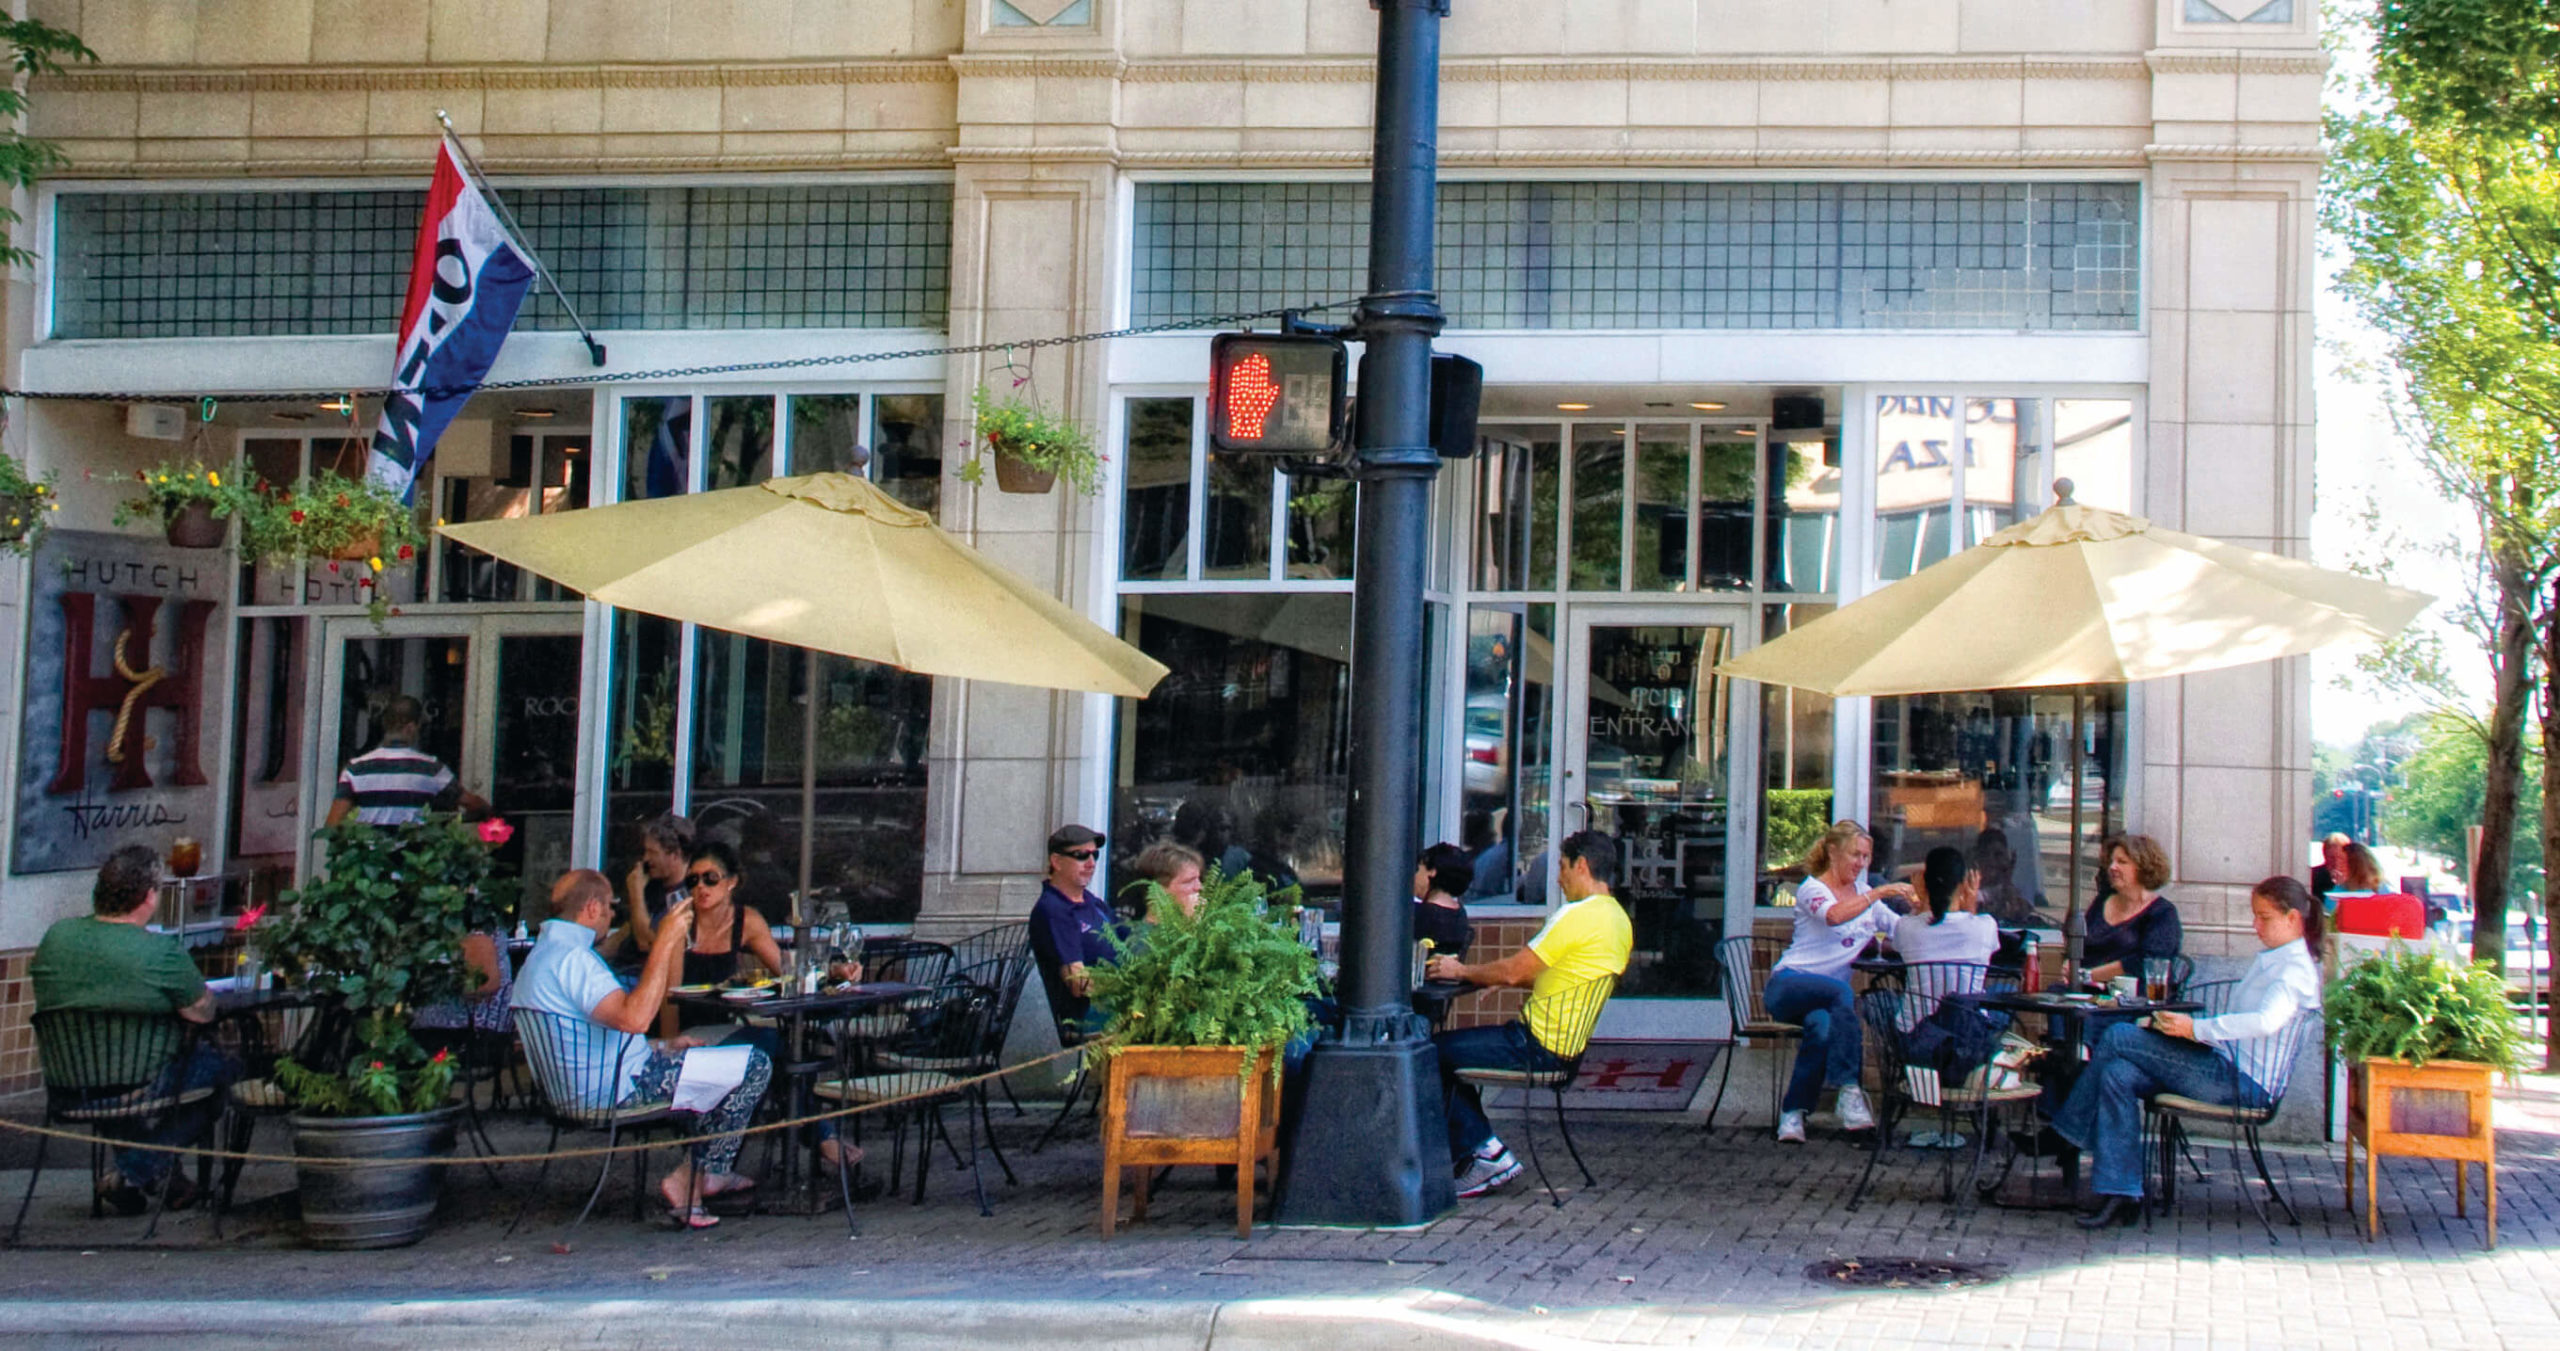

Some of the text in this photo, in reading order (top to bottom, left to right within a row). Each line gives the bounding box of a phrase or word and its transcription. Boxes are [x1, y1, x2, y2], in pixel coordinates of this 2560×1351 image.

[66, 559, 199, 590] HUTCH
[525, 697, 578, 717] ROO
[1590, 715, 1700, 738] ENTRAN
[63, 782, 187, 840] Harris
